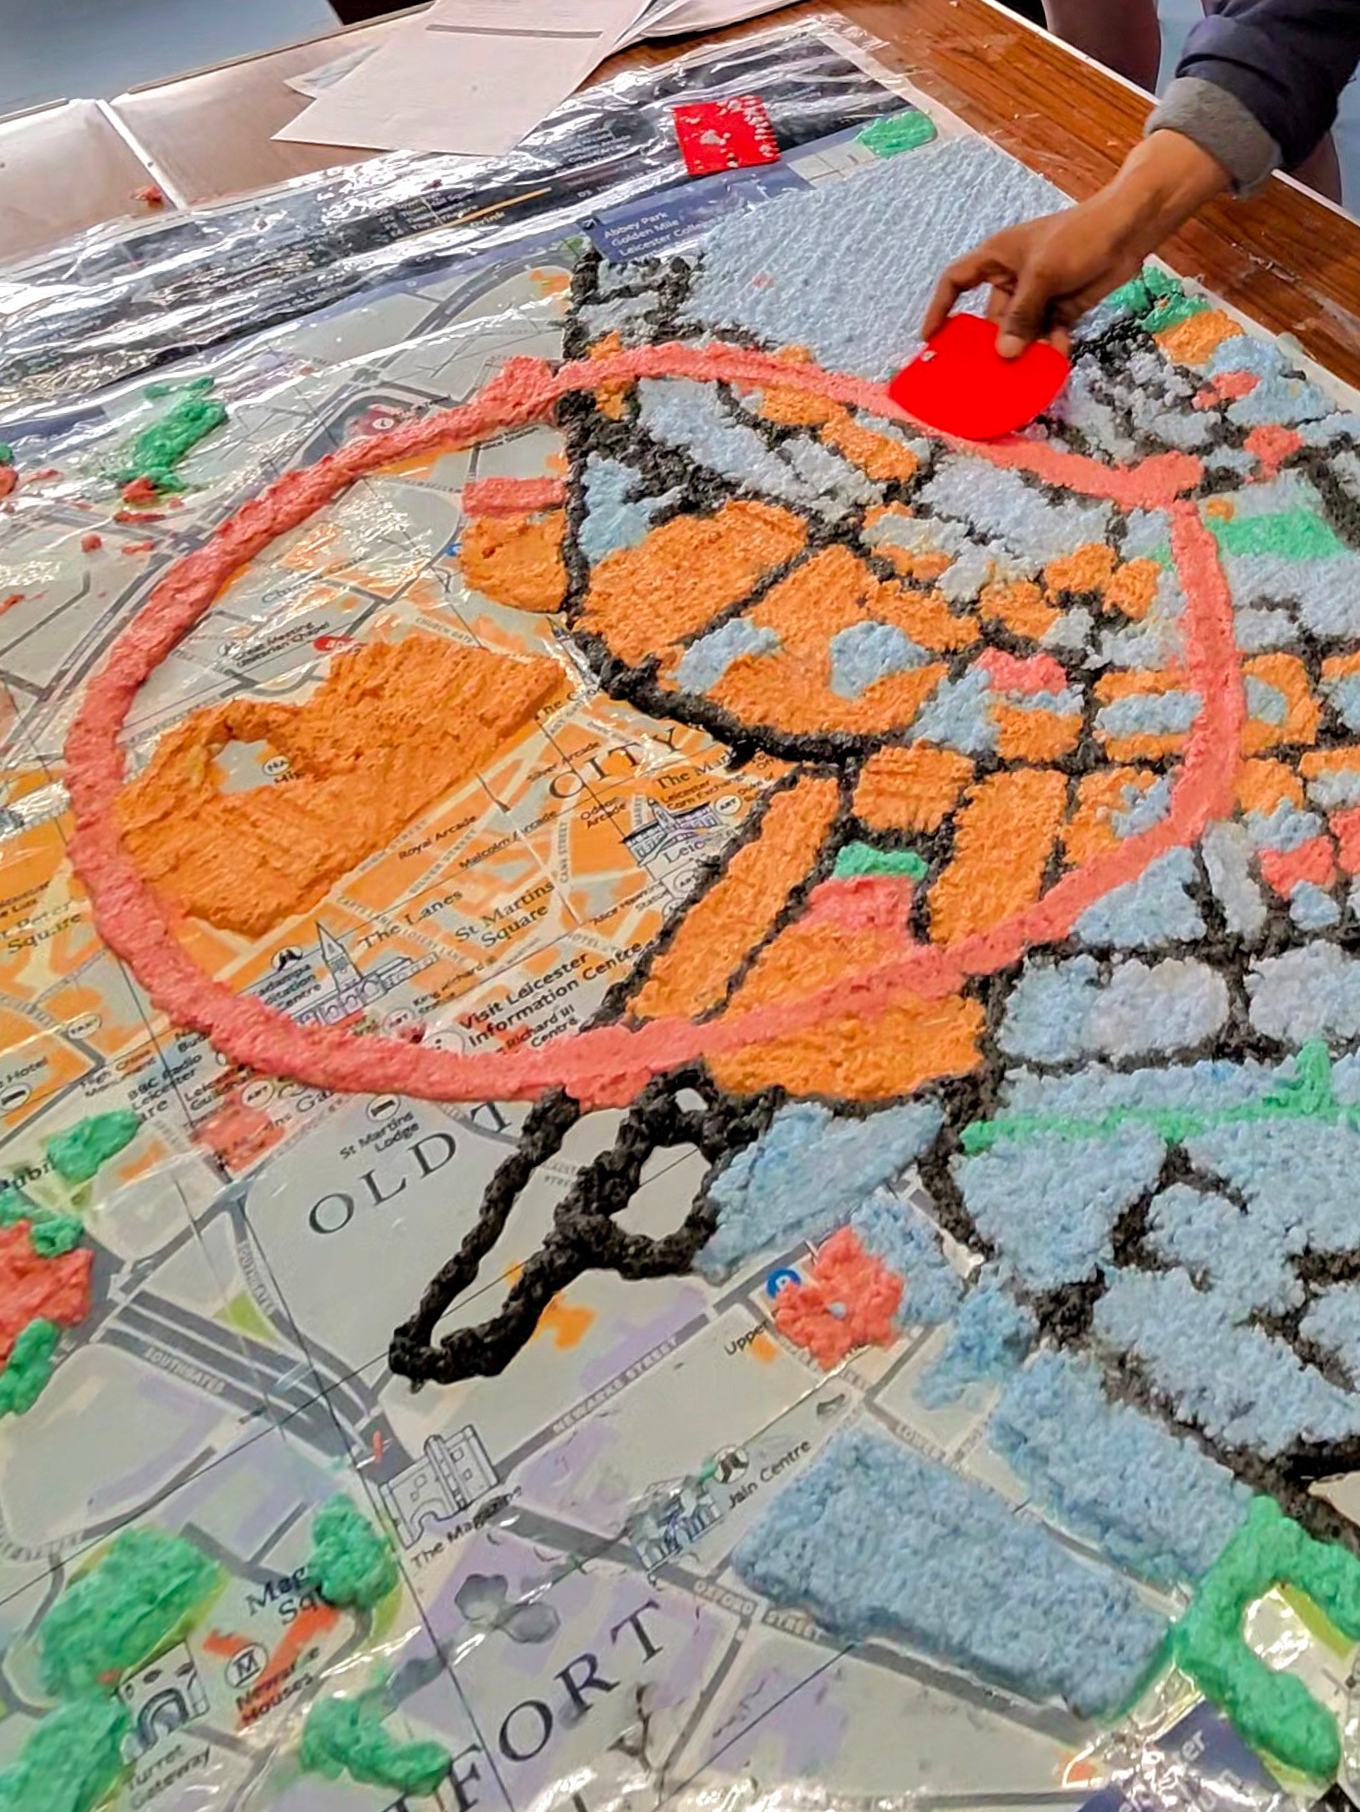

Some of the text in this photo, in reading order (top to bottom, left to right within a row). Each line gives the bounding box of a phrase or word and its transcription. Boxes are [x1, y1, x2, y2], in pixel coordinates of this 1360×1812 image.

[604, 210, 668, 239] Abbey Park
[611, 219, 680, 248] Golden Mile
[619, 234, 671, 257] Leicester
[655, 771, 691, 789] The
[660, 780, 711, 804] Leicester
[666, 793, 696, 810] Corn
[719, 798, 737, 811] ART
[398, 815, 477, 860] Royal Arcade
[459, 836, 511, 869] Malcolm
[8, 913, 82, 954] Square
[358, 889, 464, 949] The Lanes
[454, 882, 556, 944] St Martins
[481, 903, 550, 949] Square
[458, 999, 504, 1032] Visit
[505, 951, 589, 1006] Leicester
[468, 978, 581, 1048] Information
[581, 942, 642, 981] Centre
[530, 1017, 580, 1049] Centre
[7, 1056, 49, 1083] Hotel
[127, 1054, 203, 1101] BBC Radio
[131, 1067, 196, 1112] Leicester
[247, 1084, 269, 1102] ART
[339, 1109, 415, 1162] St Martins
[374, 1122, 420, 1153] Lodge
[308, 1131, 458, 1236] OLD
[624, 1335, 678, 1381] STREET
[723, 1320, 769, 1356] Upper
[144, 1347, 227, 1393] SOUTHGATES
[727, 1439, 813, 1511] Jain Centre
[410, 1541, 445, 1569] The
[693, 1579, 823, 1642] OXFORD STREET
[241, 1671, 315, 1725] Houses
[131, 1745, 211, 1810] Gateway
